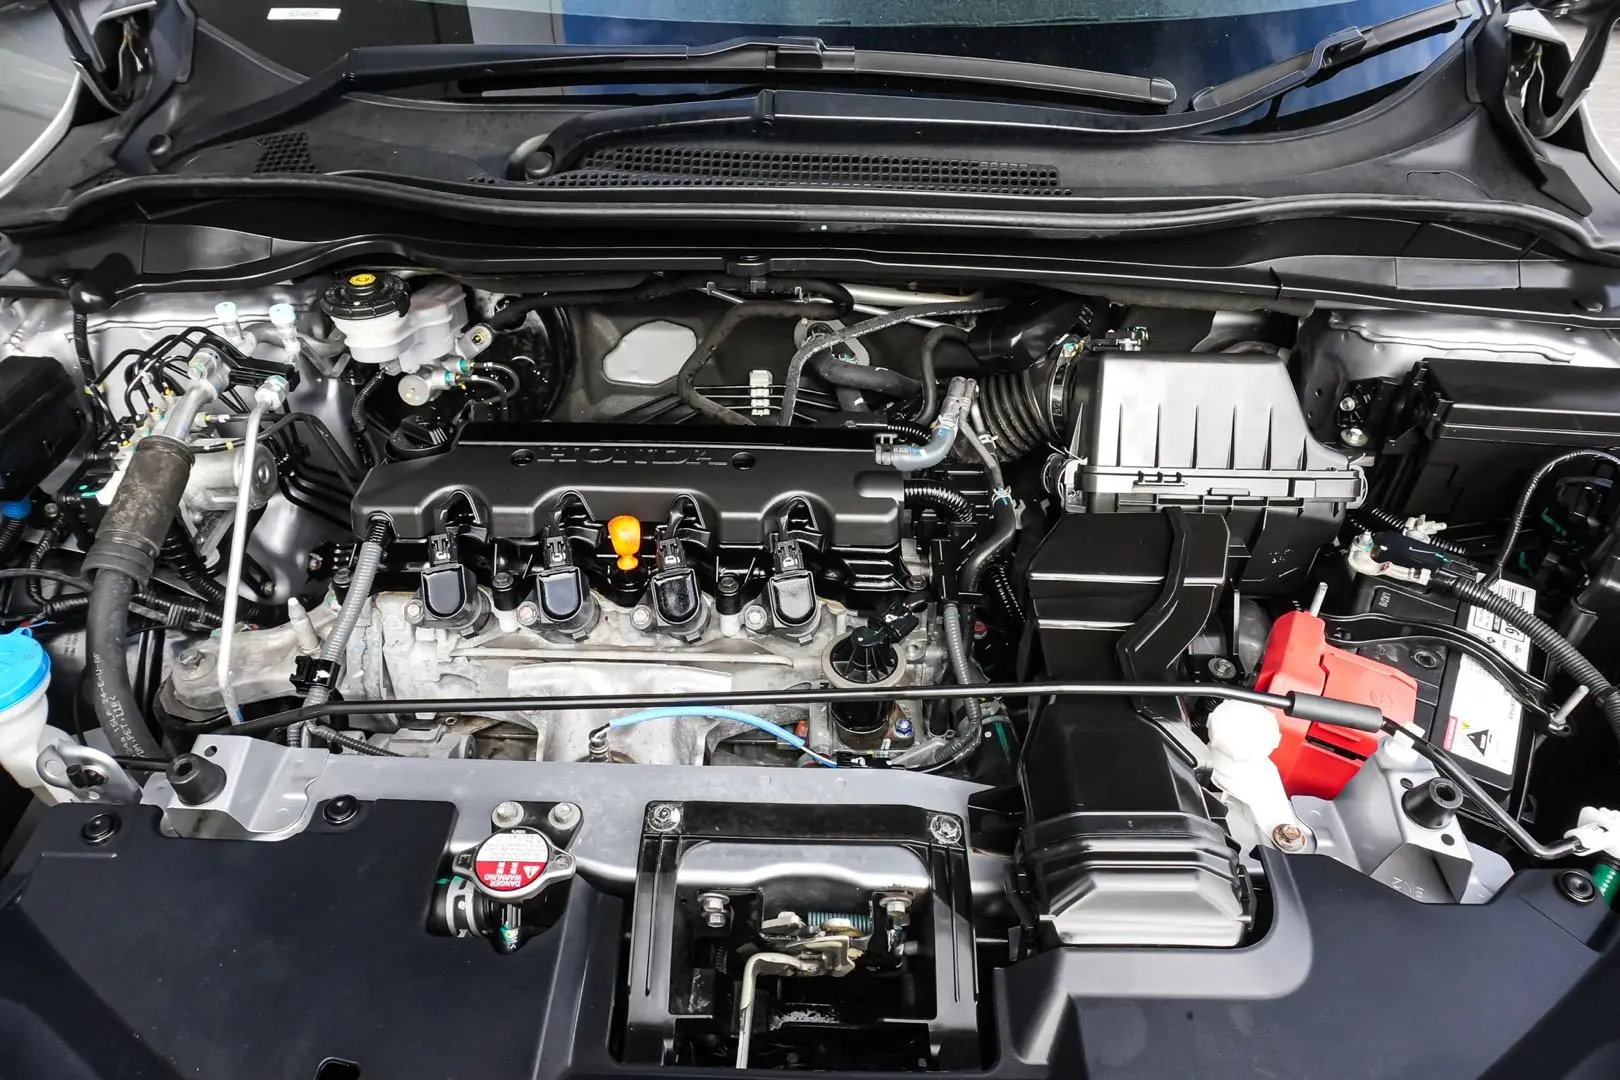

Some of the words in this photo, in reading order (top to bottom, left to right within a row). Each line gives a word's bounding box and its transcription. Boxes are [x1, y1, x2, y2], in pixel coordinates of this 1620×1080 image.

[536, 447, 728, 466] HONDA
[484, 873, 522, 881] WARNUNG
[489, 880, 521, 888] DANGER
